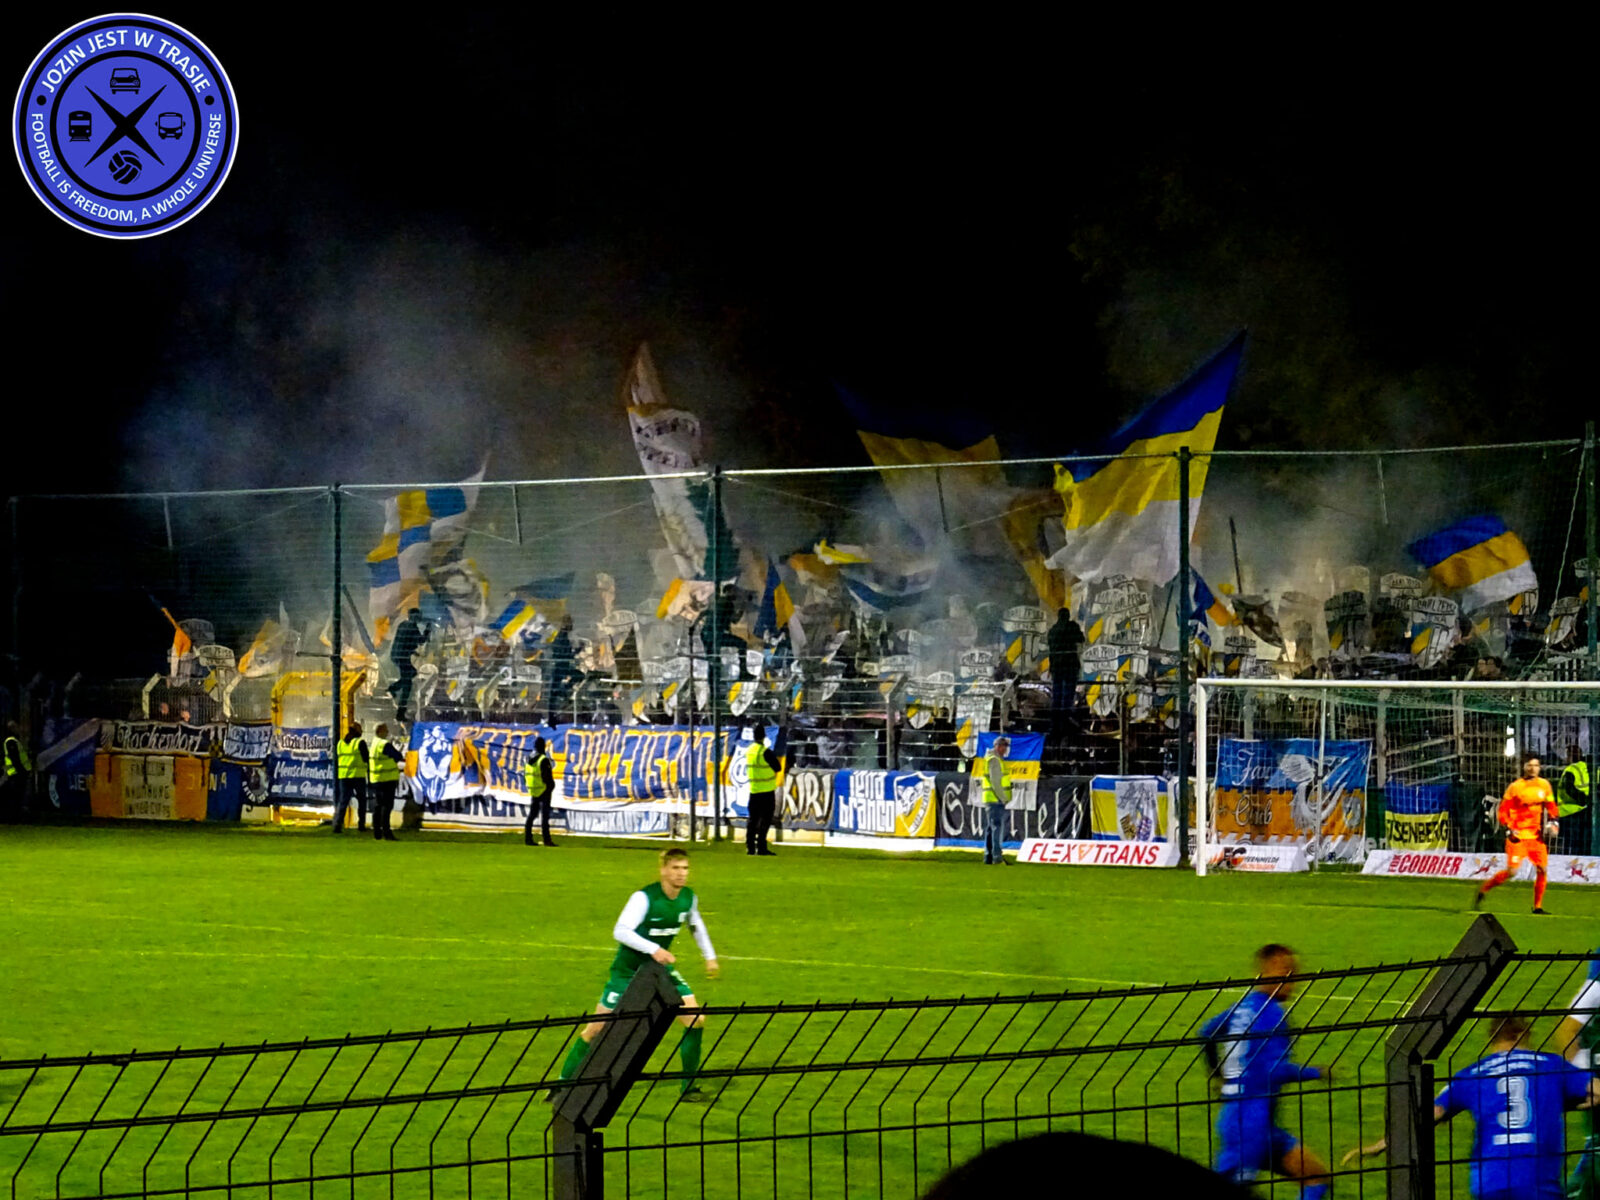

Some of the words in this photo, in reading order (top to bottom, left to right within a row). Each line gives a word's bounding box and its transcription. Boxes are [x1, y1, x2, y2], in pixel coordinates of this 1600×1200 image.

[117, 722, 203, 753] Rockendorf
[839, 795, 895, 832] branco
[942, 782, 1083, 840] Salfeld
[1028, 842, 1077, 863] FLEX
[1093, 843, 1160, 866] TRANS
[1398, 854, 1463, 875] COURIER
[1496, 1074, 1532, 1129] 3
